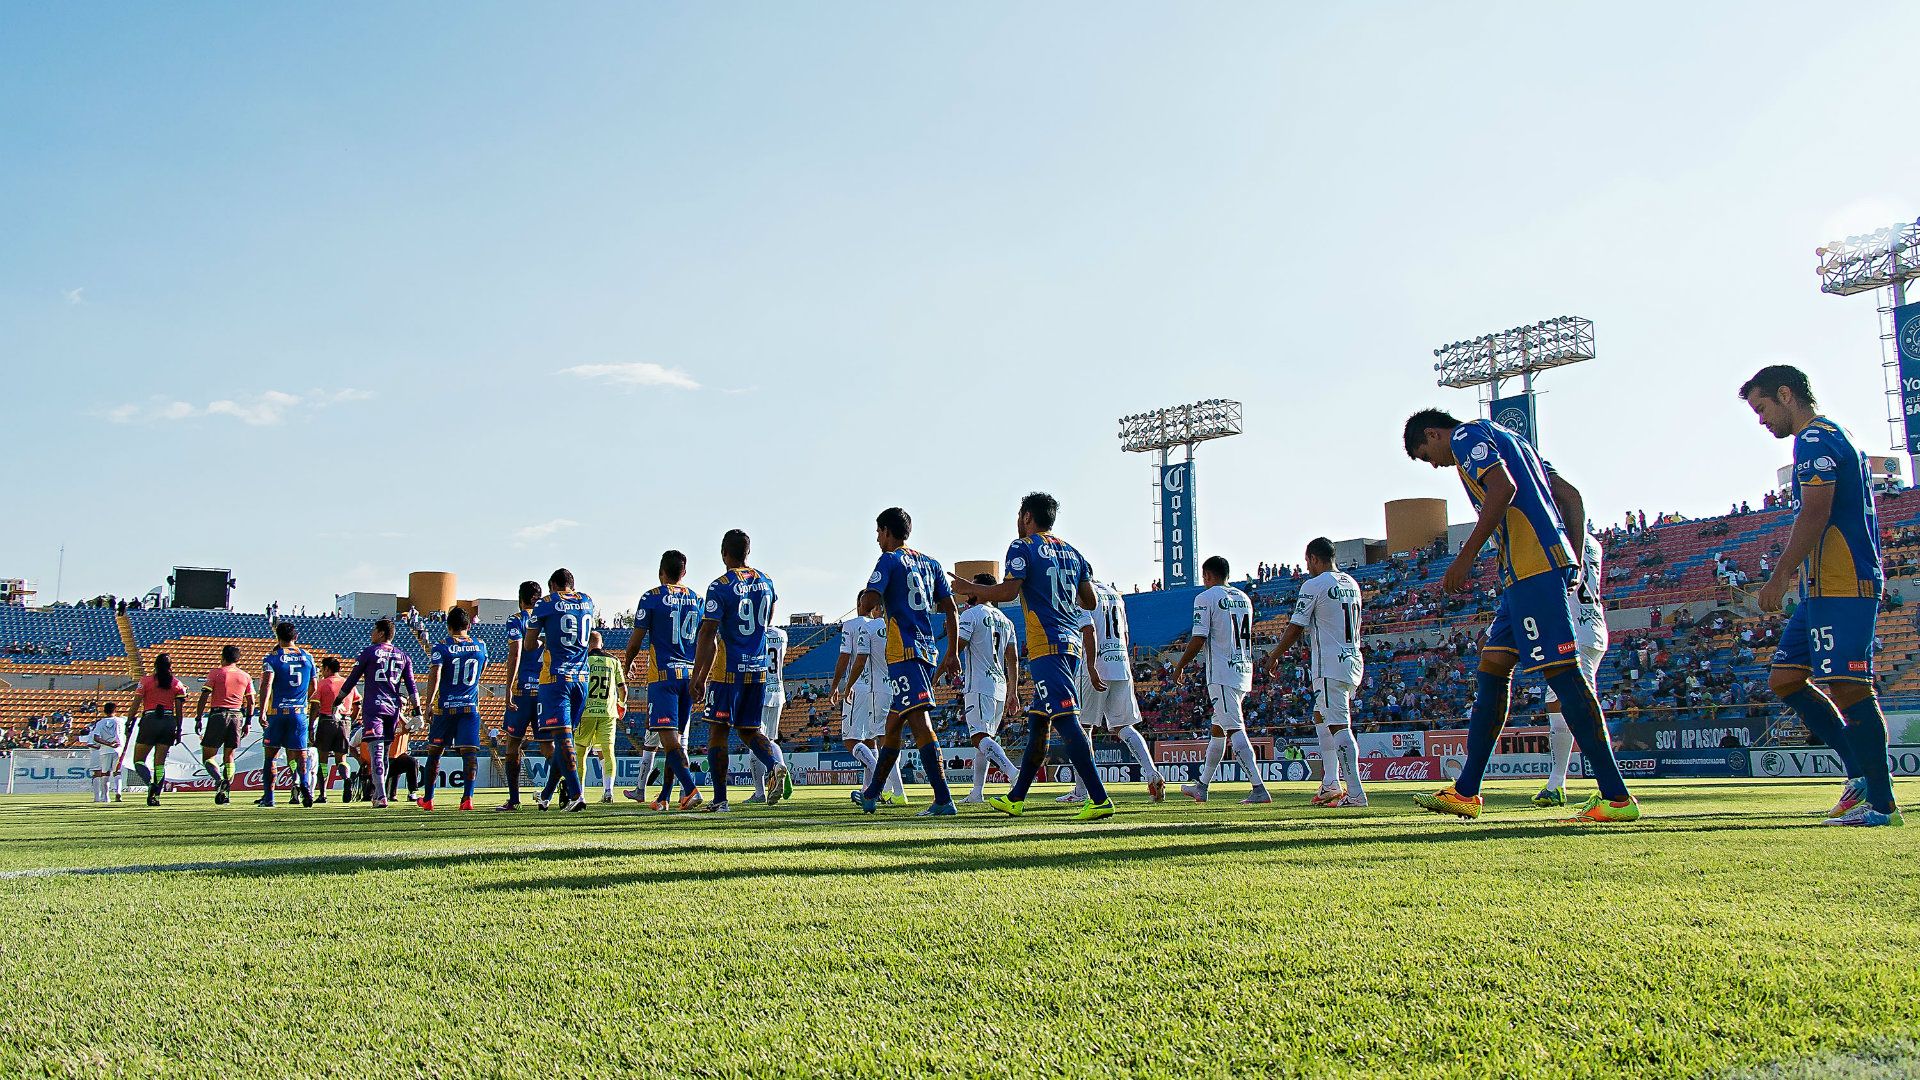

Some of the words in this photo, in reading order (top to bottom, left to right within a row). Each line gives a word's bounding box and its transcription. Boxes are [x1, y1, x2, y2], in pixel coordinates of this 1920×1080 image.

[1164, 465, 1187, 577] Corona
[560, 614, 592, 647] 90
[1231, 613, 1251, 650] 14
[1523, 616, 1540, 640] 9
[1810, 625, 1834, 652] 35
[289, 664, 302, 687] 5
[451, 657, 479, 686] 10
[588, 675, 610, 699] 25
[1035, 680, 1048, 700] 15
